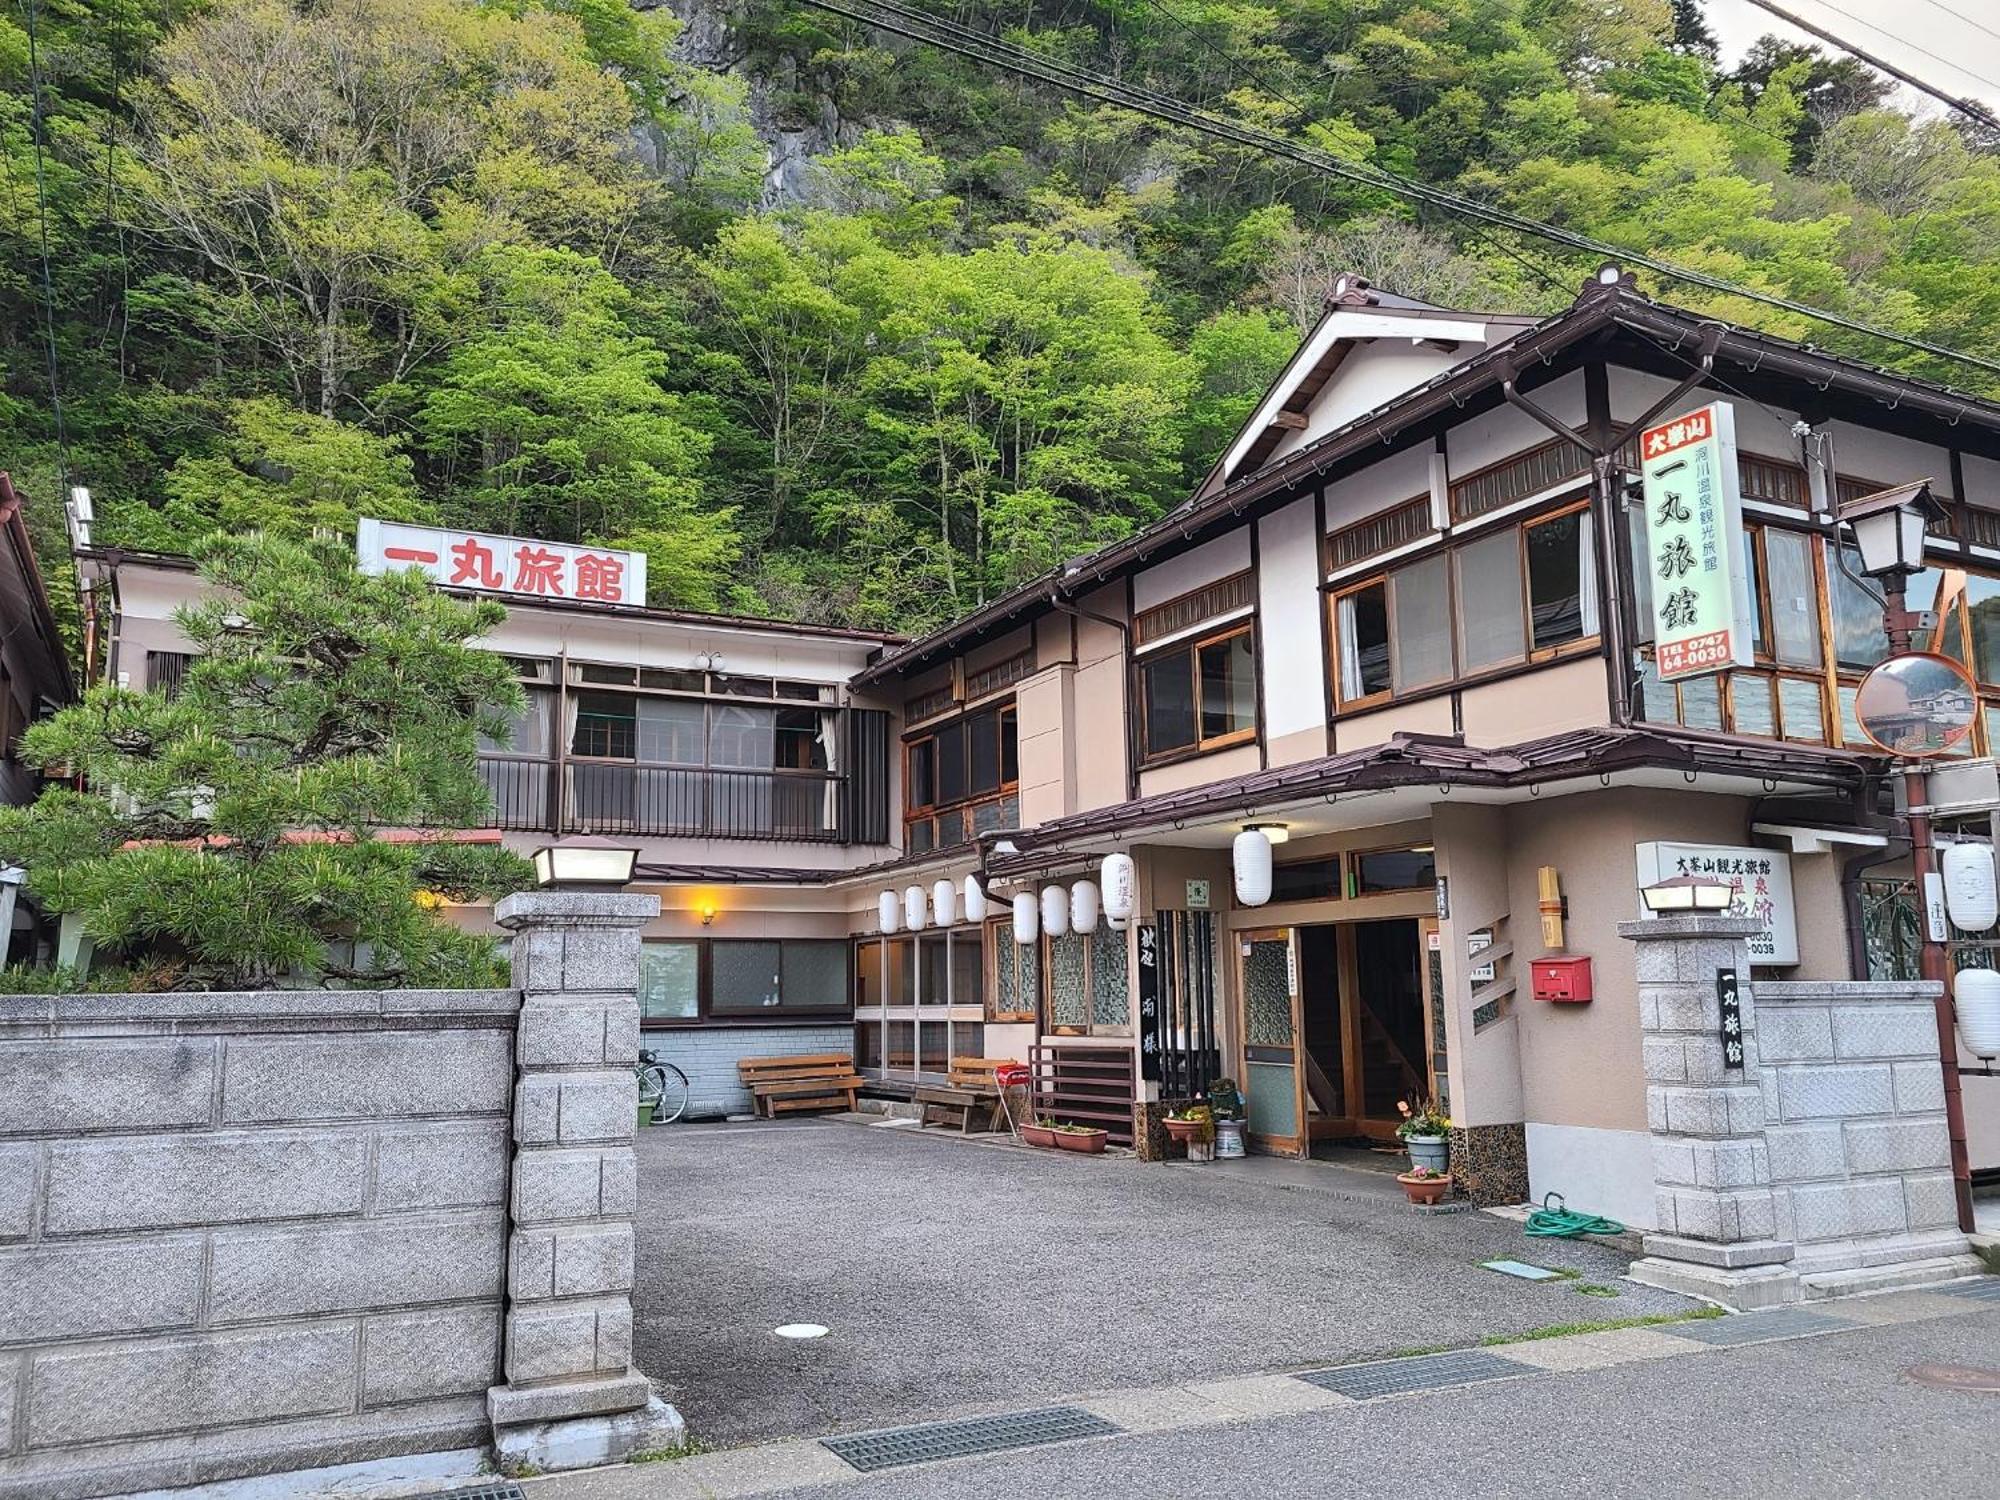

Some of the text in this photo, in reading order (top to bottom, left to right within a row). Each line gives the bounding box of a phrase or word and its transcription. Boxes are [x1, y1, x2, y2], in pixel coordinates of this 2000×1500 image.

[384, 538, 624, 601] 一丸旅館
[1652, 459, 1699, 631] 一丸旅館
[1662, 633, 1725, 657] TEL 0747
[1663, 644, 1727, 670] 64-0030
[1721, 974, 1743, 1063] 一丸旅館
